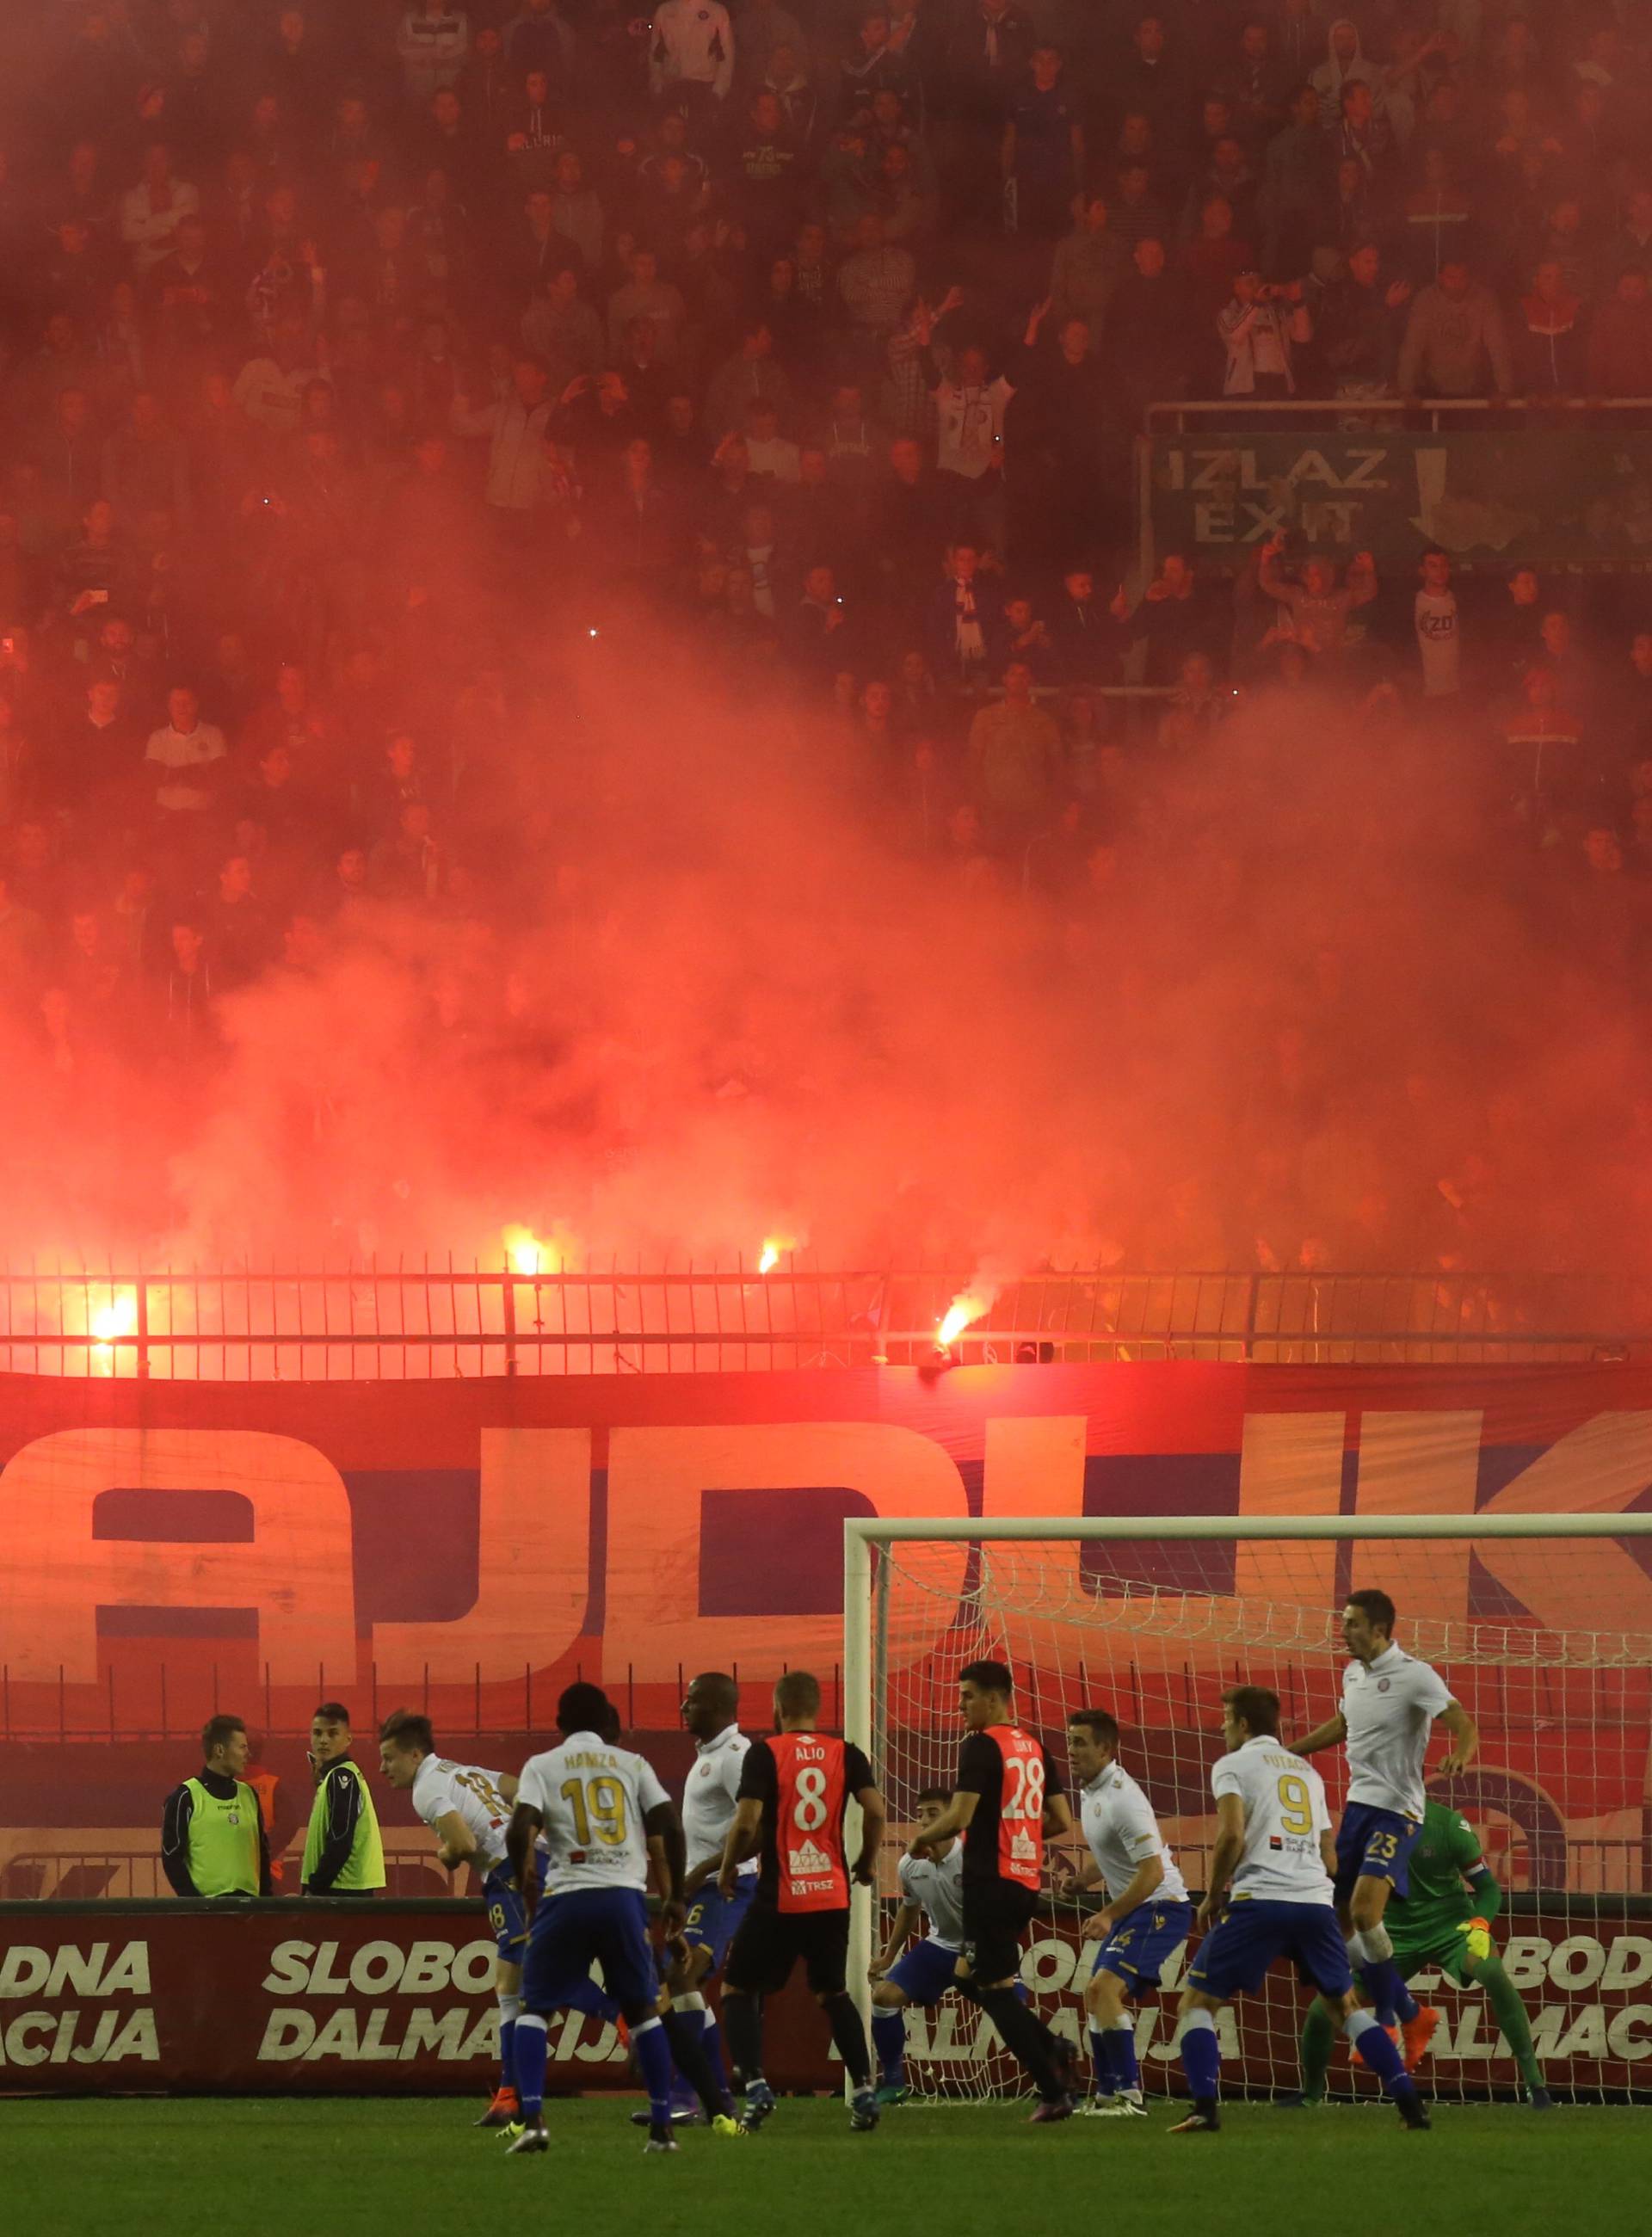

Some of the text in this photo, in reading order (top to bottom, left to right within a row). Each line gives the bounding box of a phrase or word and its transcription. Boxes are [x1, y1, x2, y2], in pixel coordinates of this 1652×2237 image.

[1168, 449, 1388, 489] IZLAZ
[1195, 502, 1363, 542] EXIT
[561, 1776, 626, 1846] 19
[794, 1767, 828, 1831] 8
[1002, 1757, 1045, 1819] 28
[1278, 1774, 1313, 1835] 9
[1365, 1831, 1398, 1858] 23
[0, 1941, 151, 1998] DNA
[262, 1939, 607, 1995] SLOBO
[0, 2007, 160, 2066] CIJA
